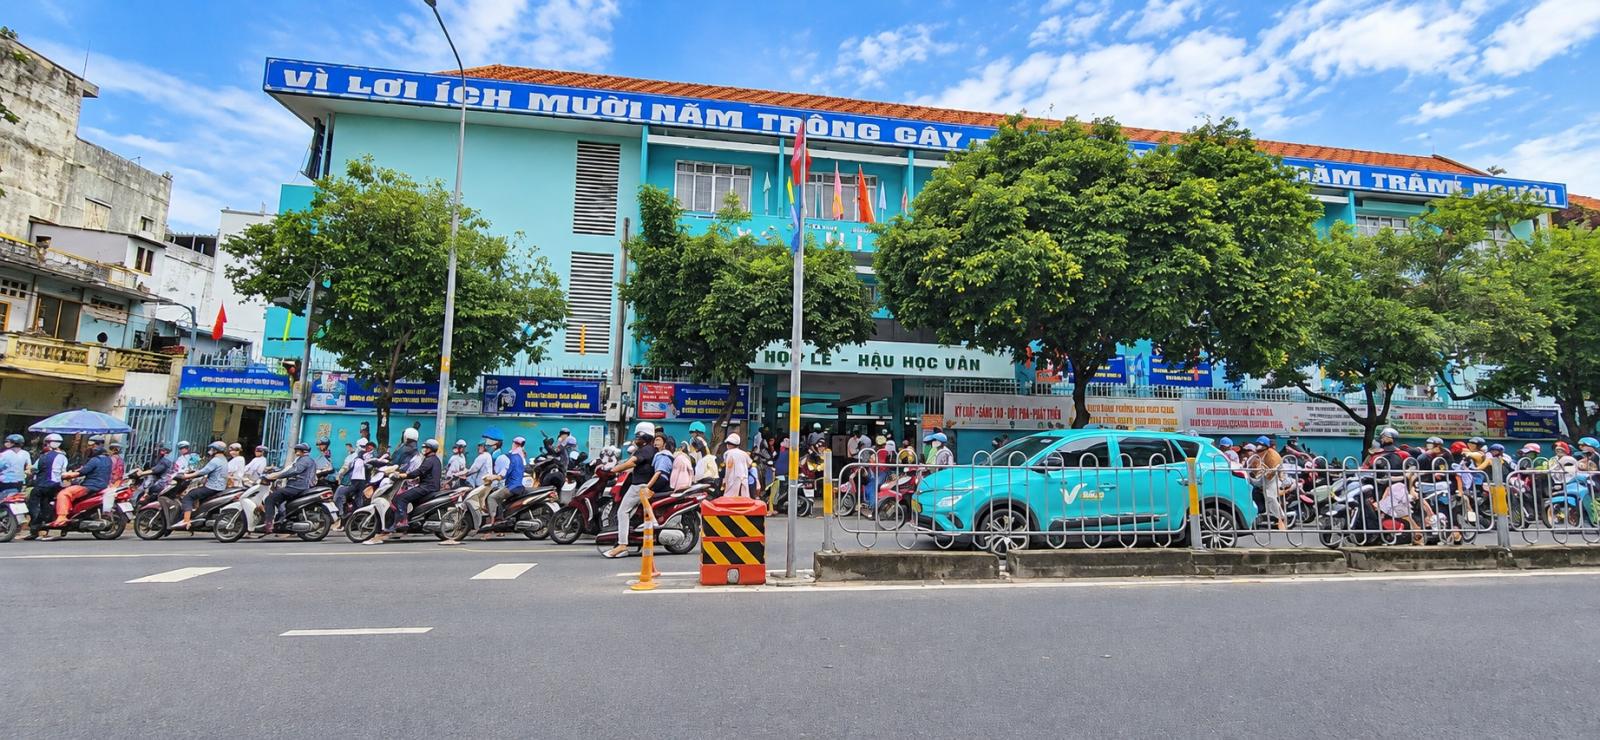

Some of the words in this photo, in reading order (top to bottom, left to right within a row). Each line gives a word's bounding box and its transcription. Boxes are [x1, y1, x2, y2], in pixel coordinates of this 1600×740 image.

[284, 68, 328, 90] VÌ
[435, 81, 512, 108] ÍCH
[528, 92, 642, 119] MƯỜI
[894, 126, 962, 147] CÂY
[858, 352, 894, 370] HẬU
[902, 356, 938, 371] HỌC
